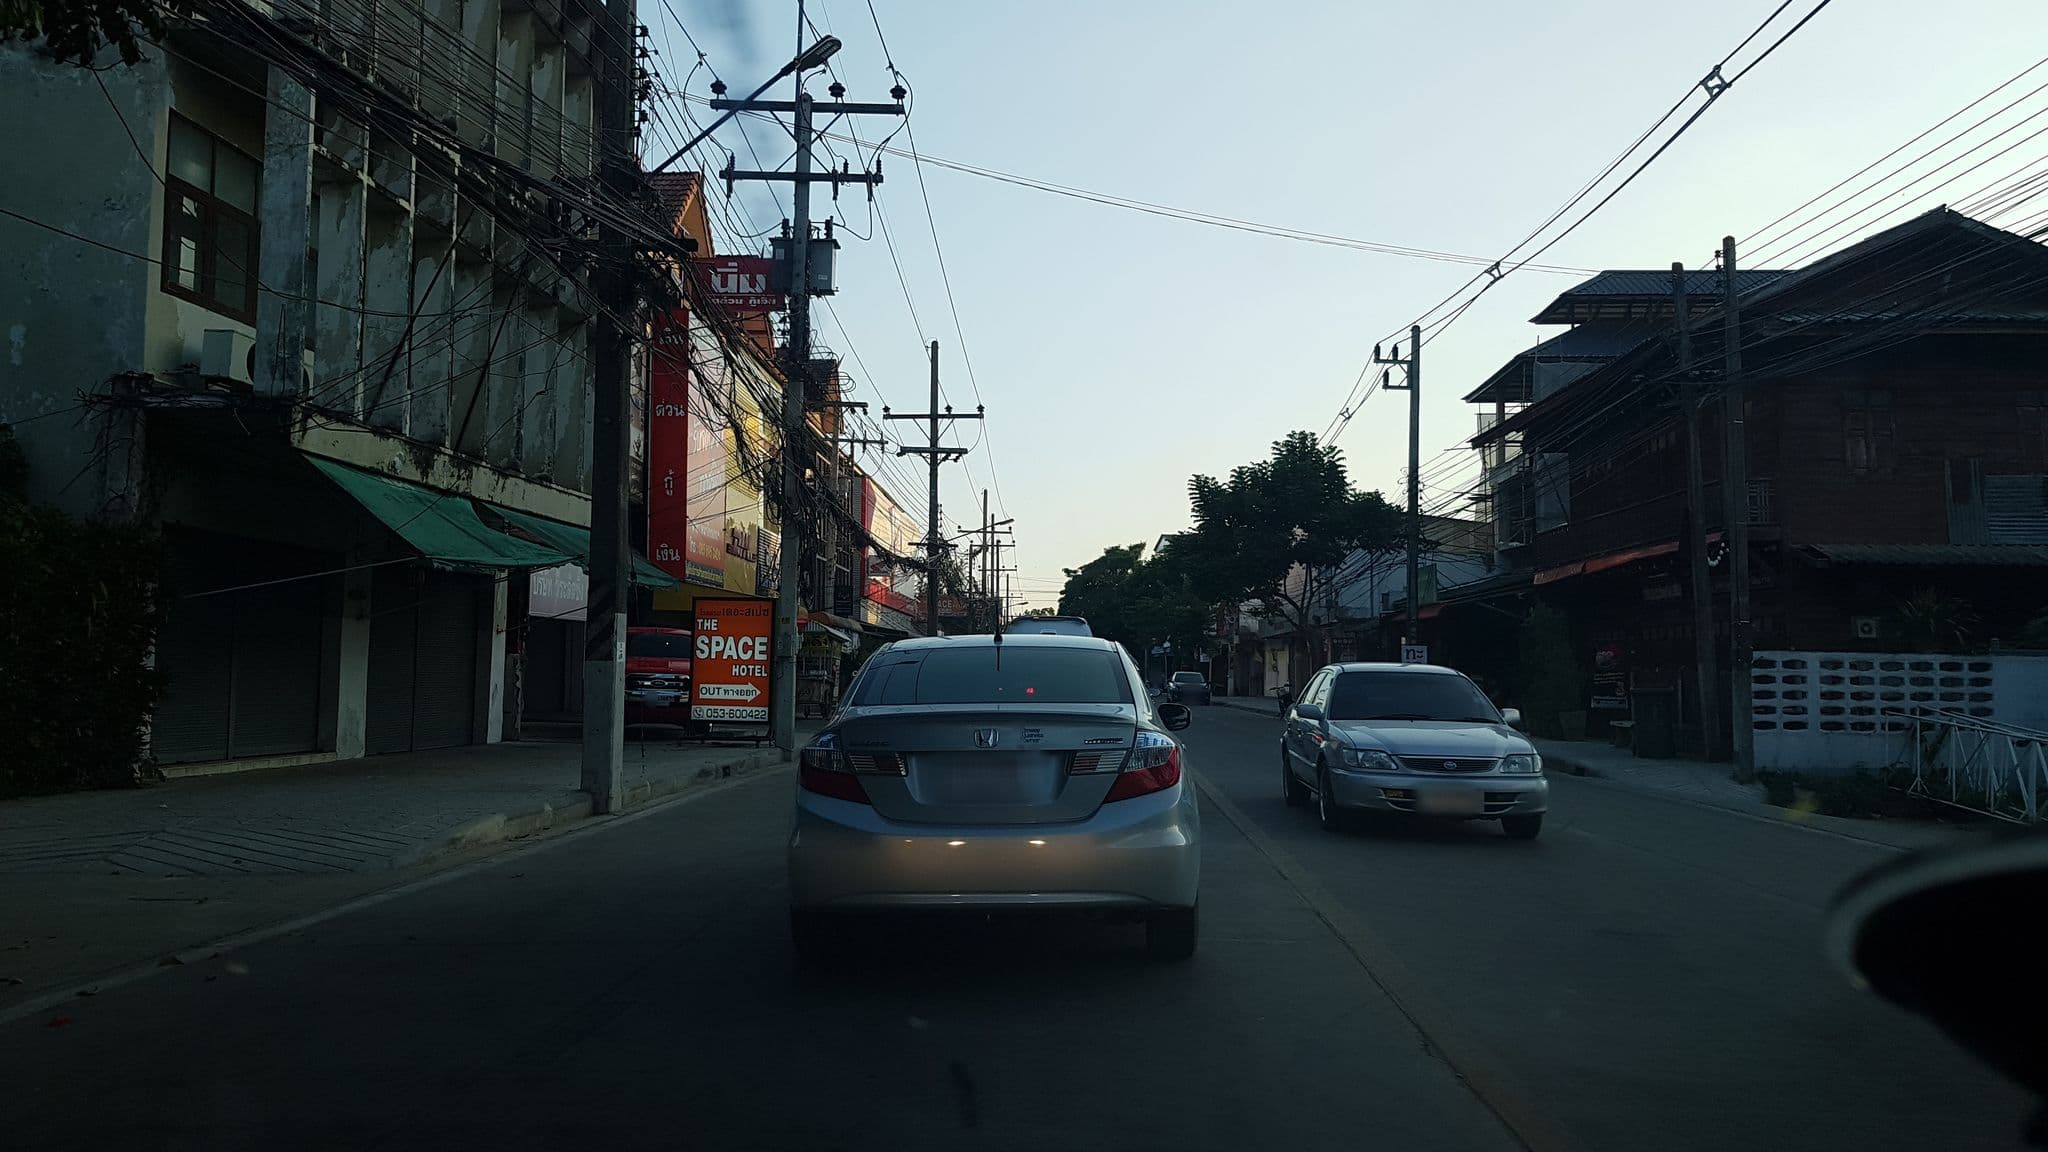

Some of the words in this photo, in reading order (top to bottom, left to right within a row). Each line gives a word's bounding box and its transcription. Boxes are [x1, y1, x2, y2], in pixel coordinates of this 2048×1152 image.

[655, 398, 685, 417] ด่วน
[663, 469, 674, 496] กู้
[656, 543, 680, 562] เงิน
[696, 618, 718, 631] THE
[695, 635, 769, 661] SPACE
[731, 664, 768, 677] HOTEL
[700, 686, 722, 696] OUT
[723, 688, 757, 698] ทางออก
[706, 708, 767, 720] 053-600422
